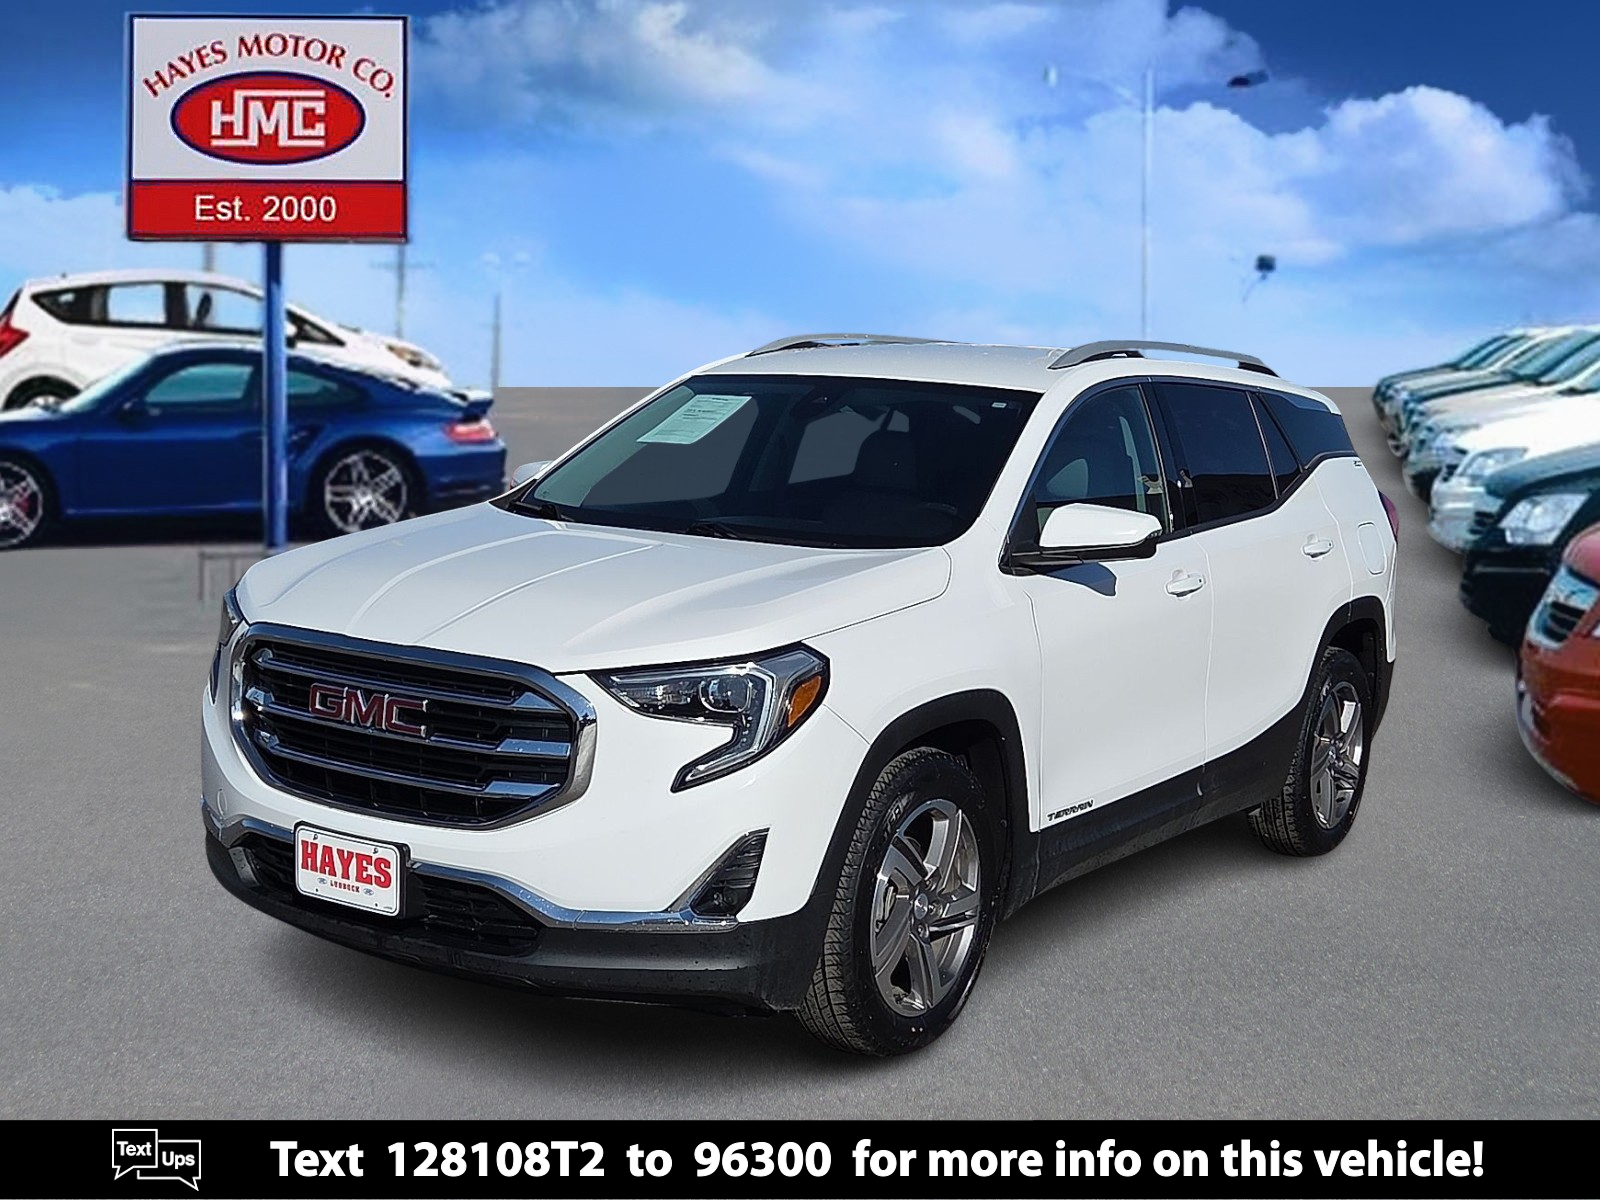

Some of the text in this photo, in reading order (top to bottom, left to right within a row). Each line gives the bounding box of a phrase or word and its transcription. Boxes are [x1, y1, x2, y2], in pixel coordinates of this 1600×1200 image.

[142, 32, 394, 98] HAYES MOTOR CO.
[210, 89, 326, 147] HMC
[194, 194, 337, 222] Est. 2000
[308, 682, 428, 737] GMC
[1047, 799, 1094, 822] TERRAIN
[301, 839, 392, 889] HAYES
